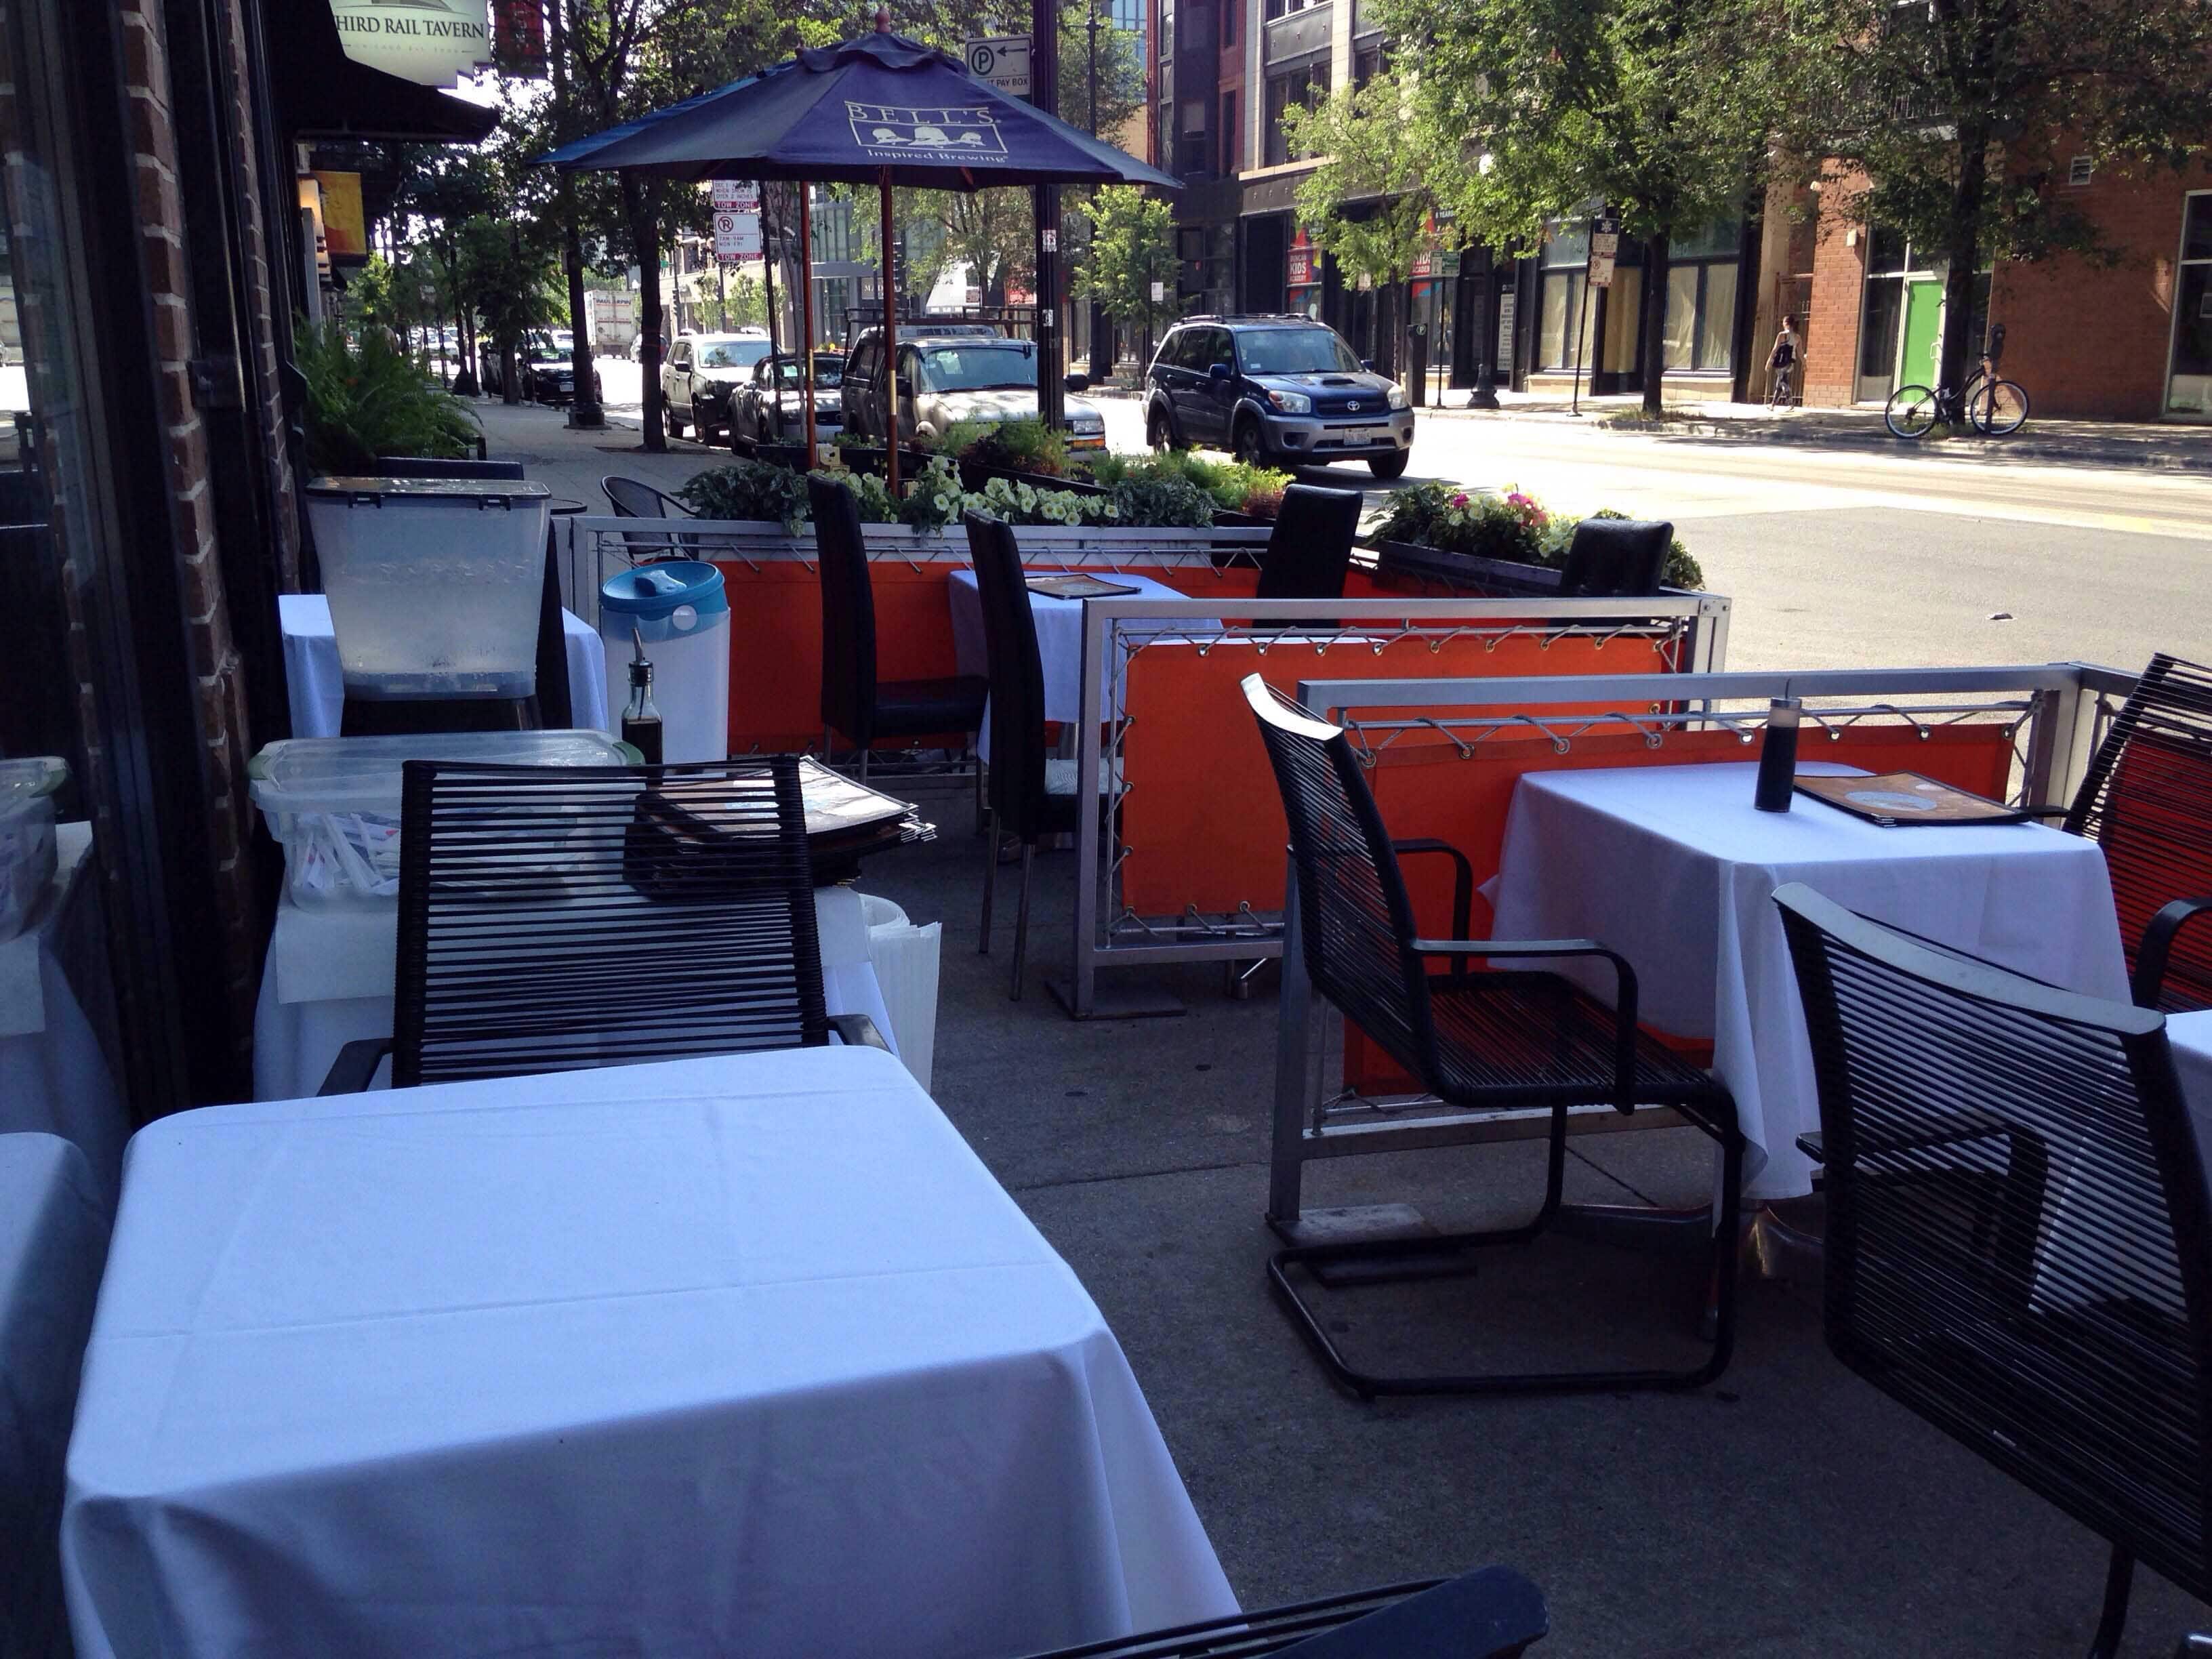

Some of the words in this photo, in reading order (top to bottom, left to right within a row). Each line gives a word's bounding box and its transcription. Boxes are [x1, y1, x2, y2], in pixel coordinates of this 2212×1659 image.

[335, 15, 380, 33] HIRD
[384, 18, 421, 35] RAIL
[422, 20, 485, 39] TAVERN
[996, 79, 1010, 87] PAY
[1012, 77, 1028, 86] BOX
[847, 104, 994, 125] BELL'S
[867, 148, 933, 160] Inspired
[939, 152, 1006, 163] Brewing
[1290, 262, 1307, 274] KIDS
